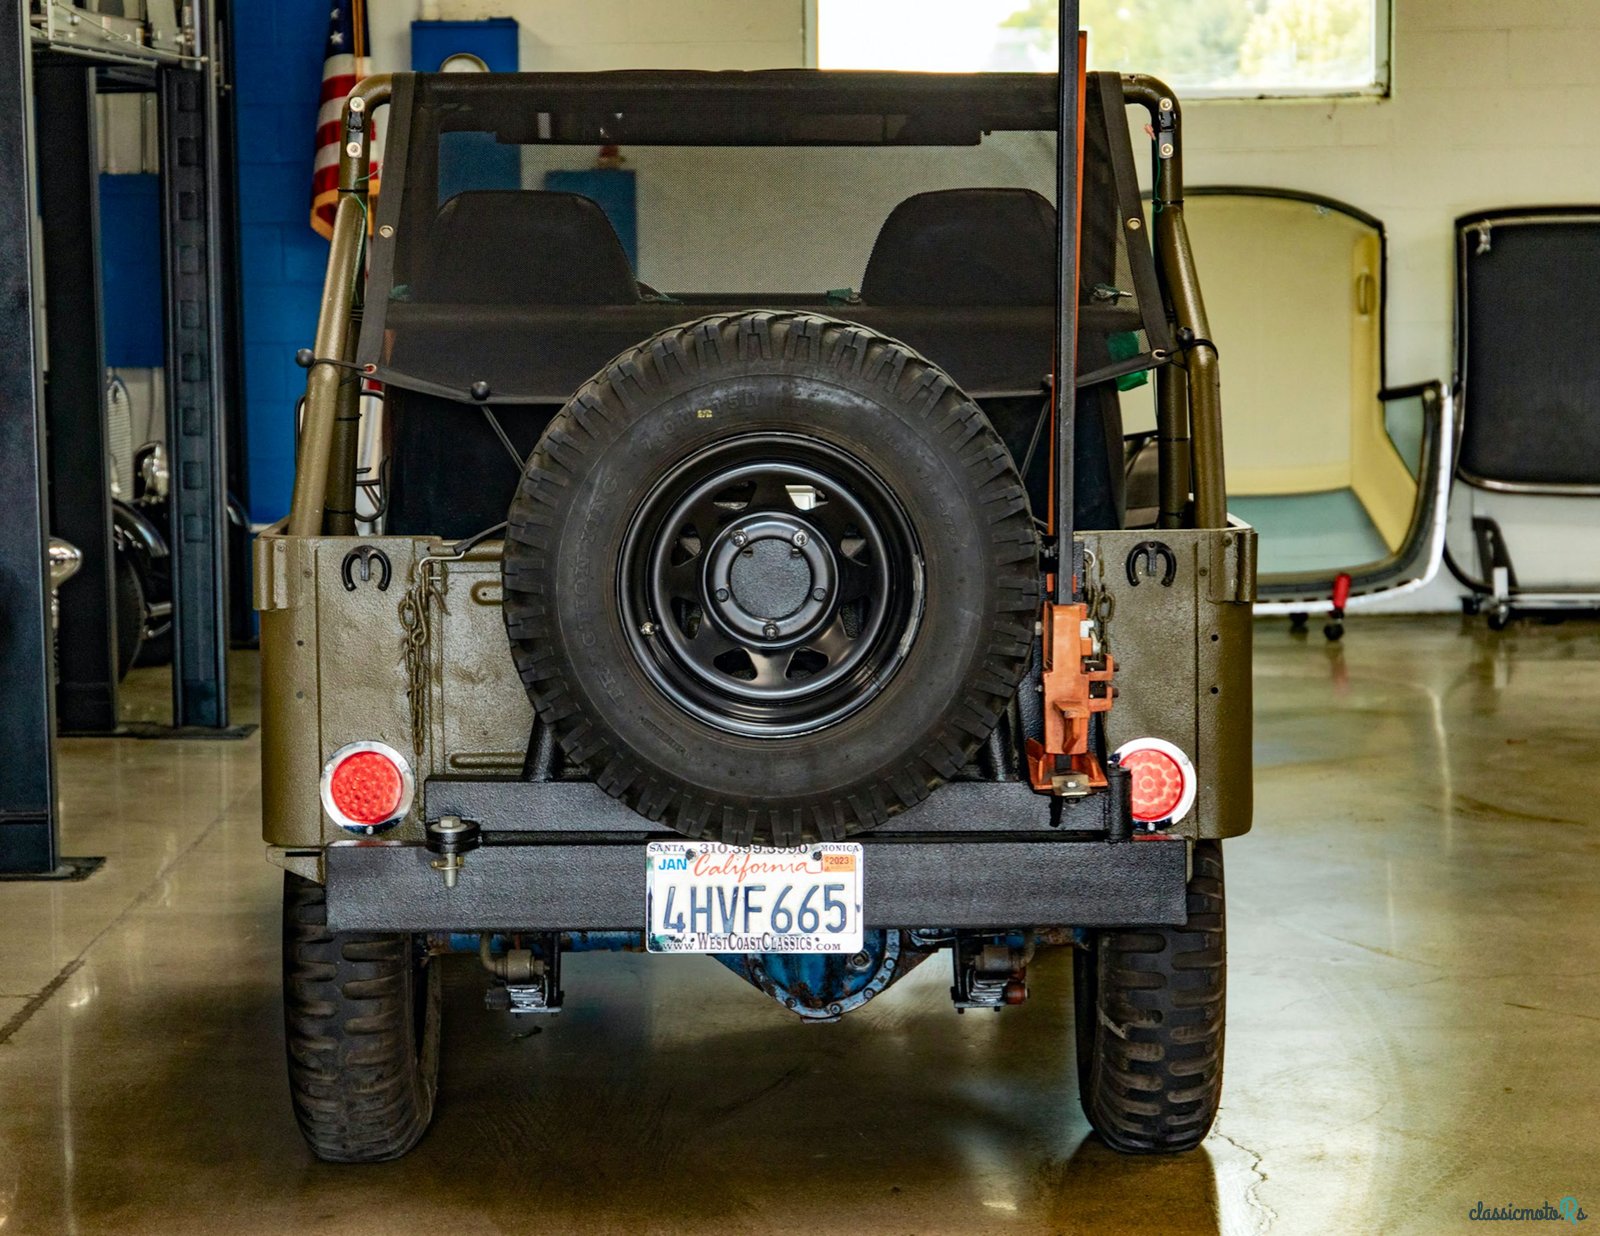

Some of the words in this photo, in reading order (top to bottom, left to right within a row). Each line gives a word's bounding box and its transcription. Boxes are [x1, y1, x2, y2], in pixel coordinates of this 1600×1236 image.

[649, 843, 686, 853] SANTA
[821, 844, 860, 853] MONICA
[658, 858, 687, 870] JAN
[829, 856, 850, 865] 2023
[694, 853, 822, 883] California
[663, 884, 848, 933] 4HVF665
